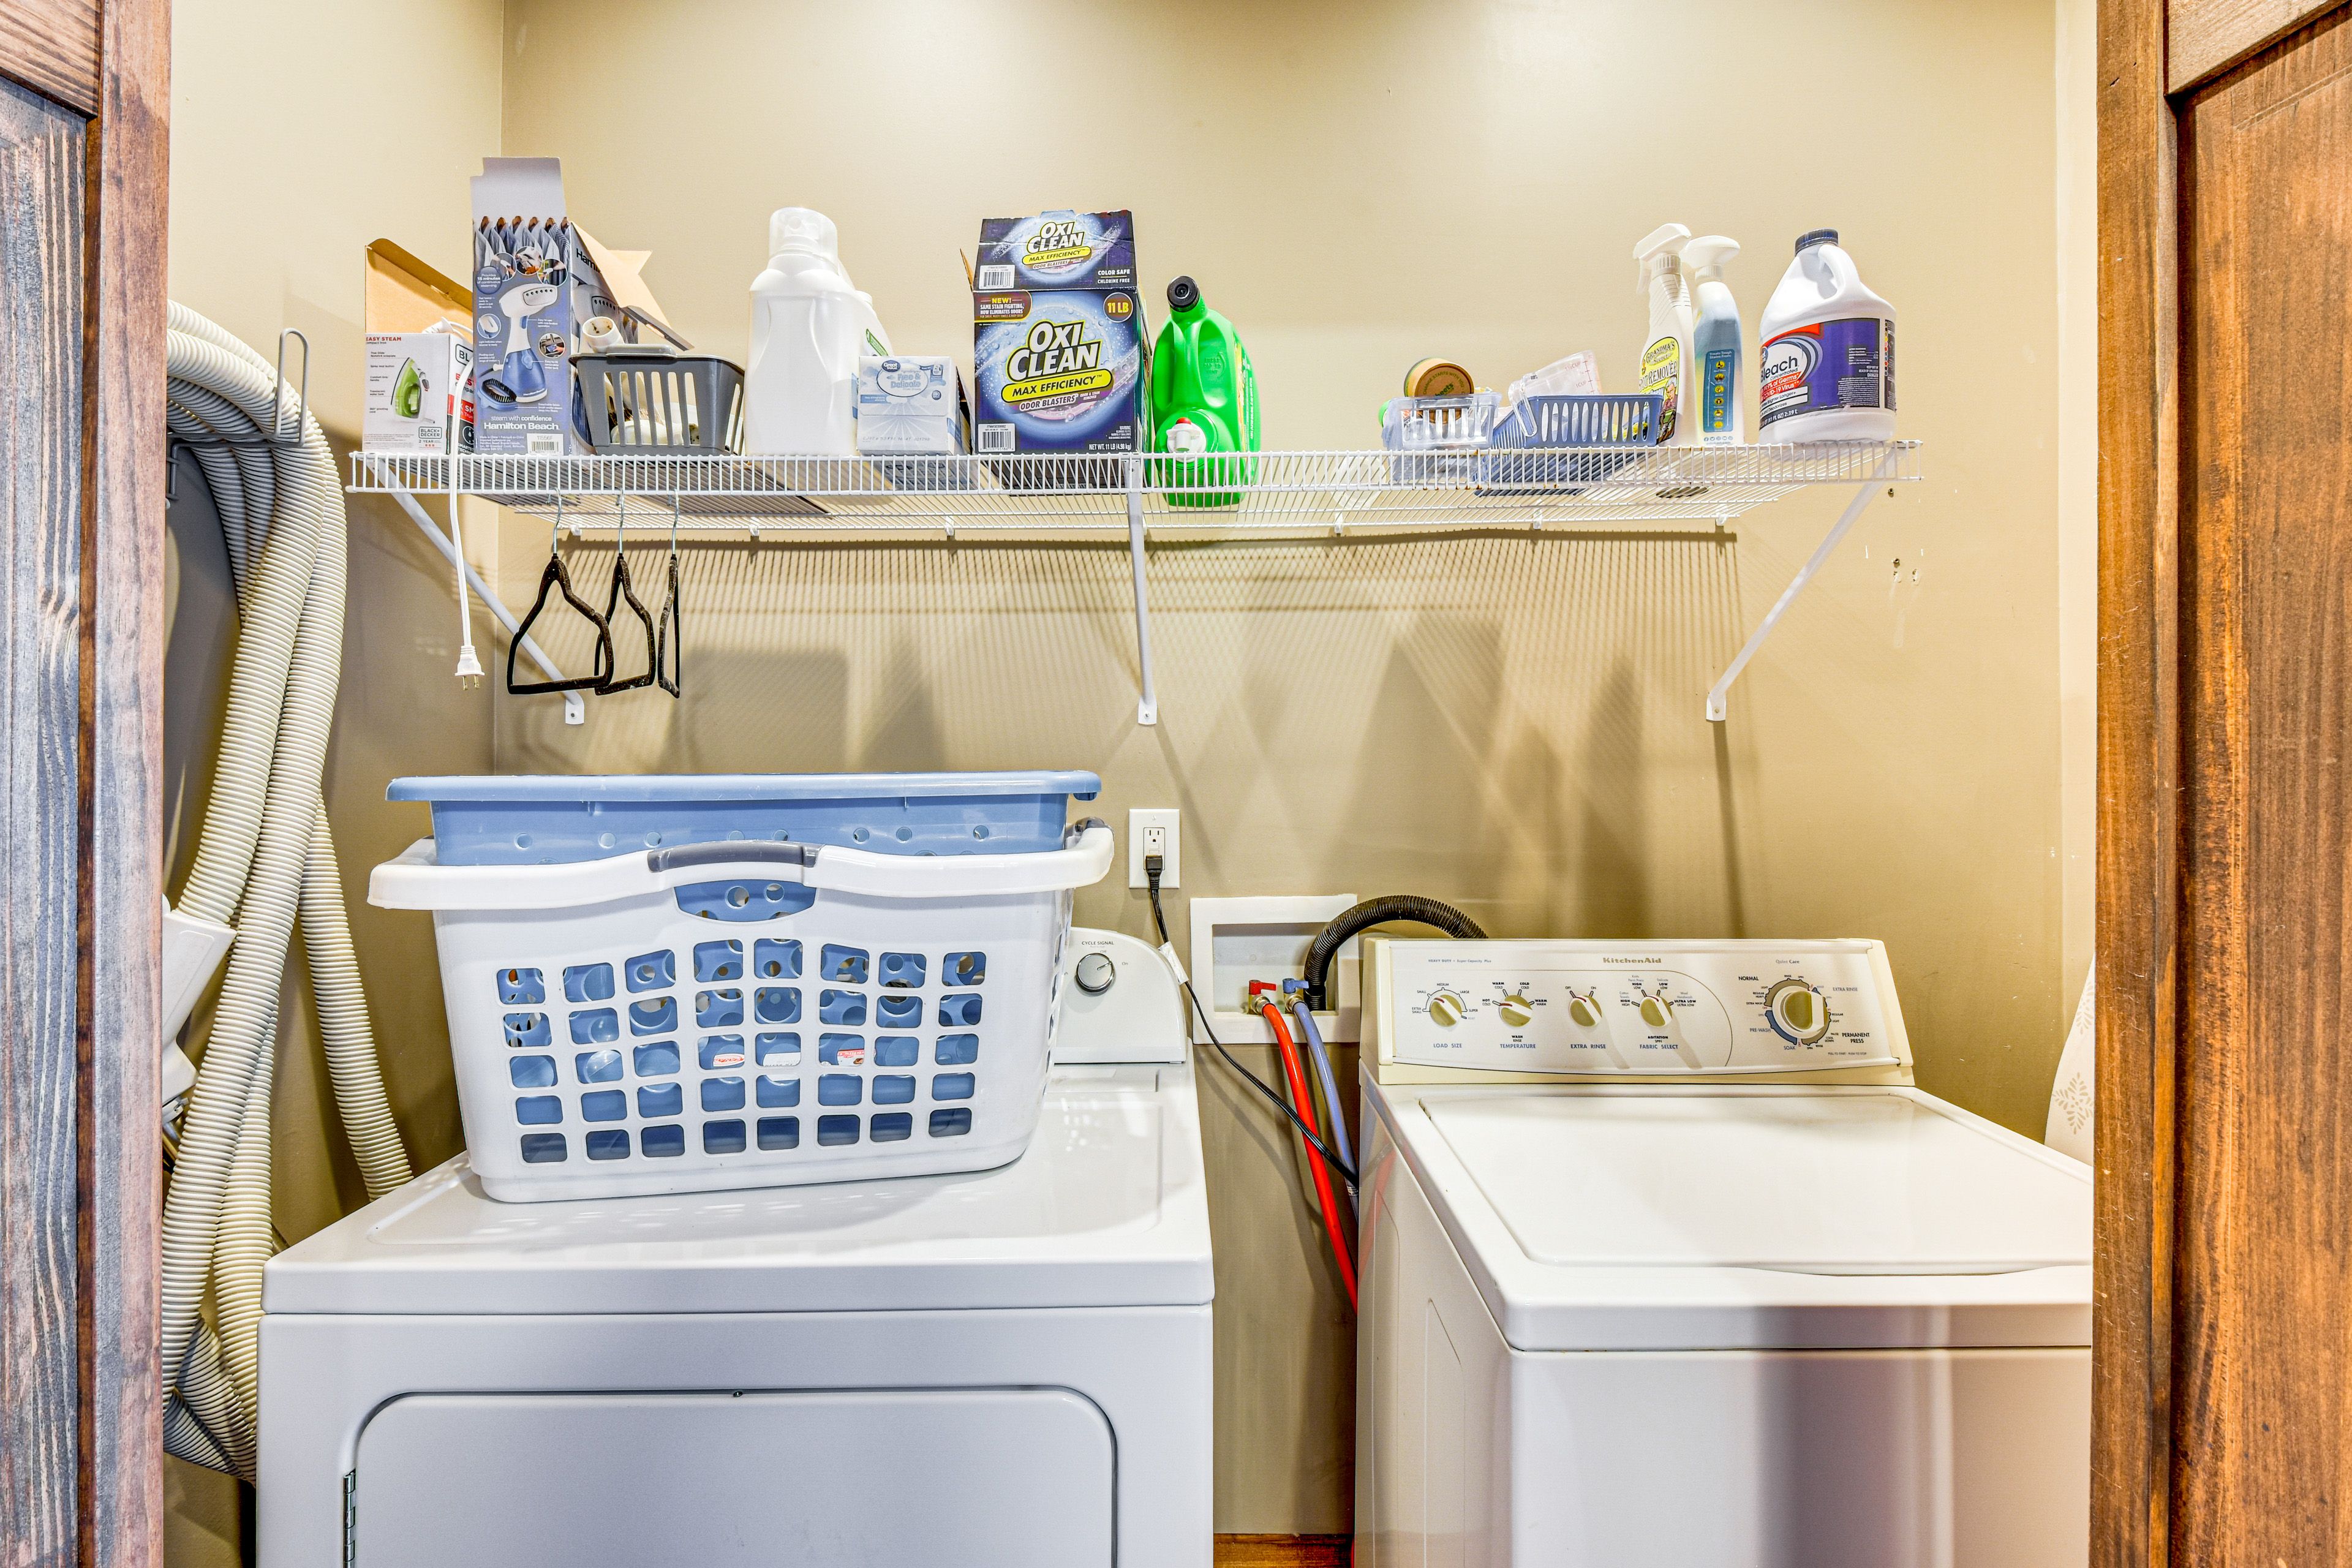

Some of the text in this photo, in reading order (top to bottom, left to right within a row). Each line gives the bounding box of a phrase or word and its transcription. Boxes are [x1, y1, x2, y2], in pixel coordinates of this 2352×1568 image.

[1041, 222, 1074, 238] OXI
[1027, 232, 1084, 254] CLEAN
[1107, 302, 1129, 314] 11 LB
[1028, 321, 1083, 353] OXI
[1008, 342, 1100, 382] CLEAN
[1646, 341, 1675, 363] GRANDMA'S
[1649, 360, 1677, 384] REMOVER
[1761, 356, 1798, 383] Bleach
[1770, 368, 1798, 380] Concentrated
[1012, 385, 1040, 397] MAX
[1423, 378, 1433, 395] CHANGE
[1449, 371, 1460, 380] WITH
